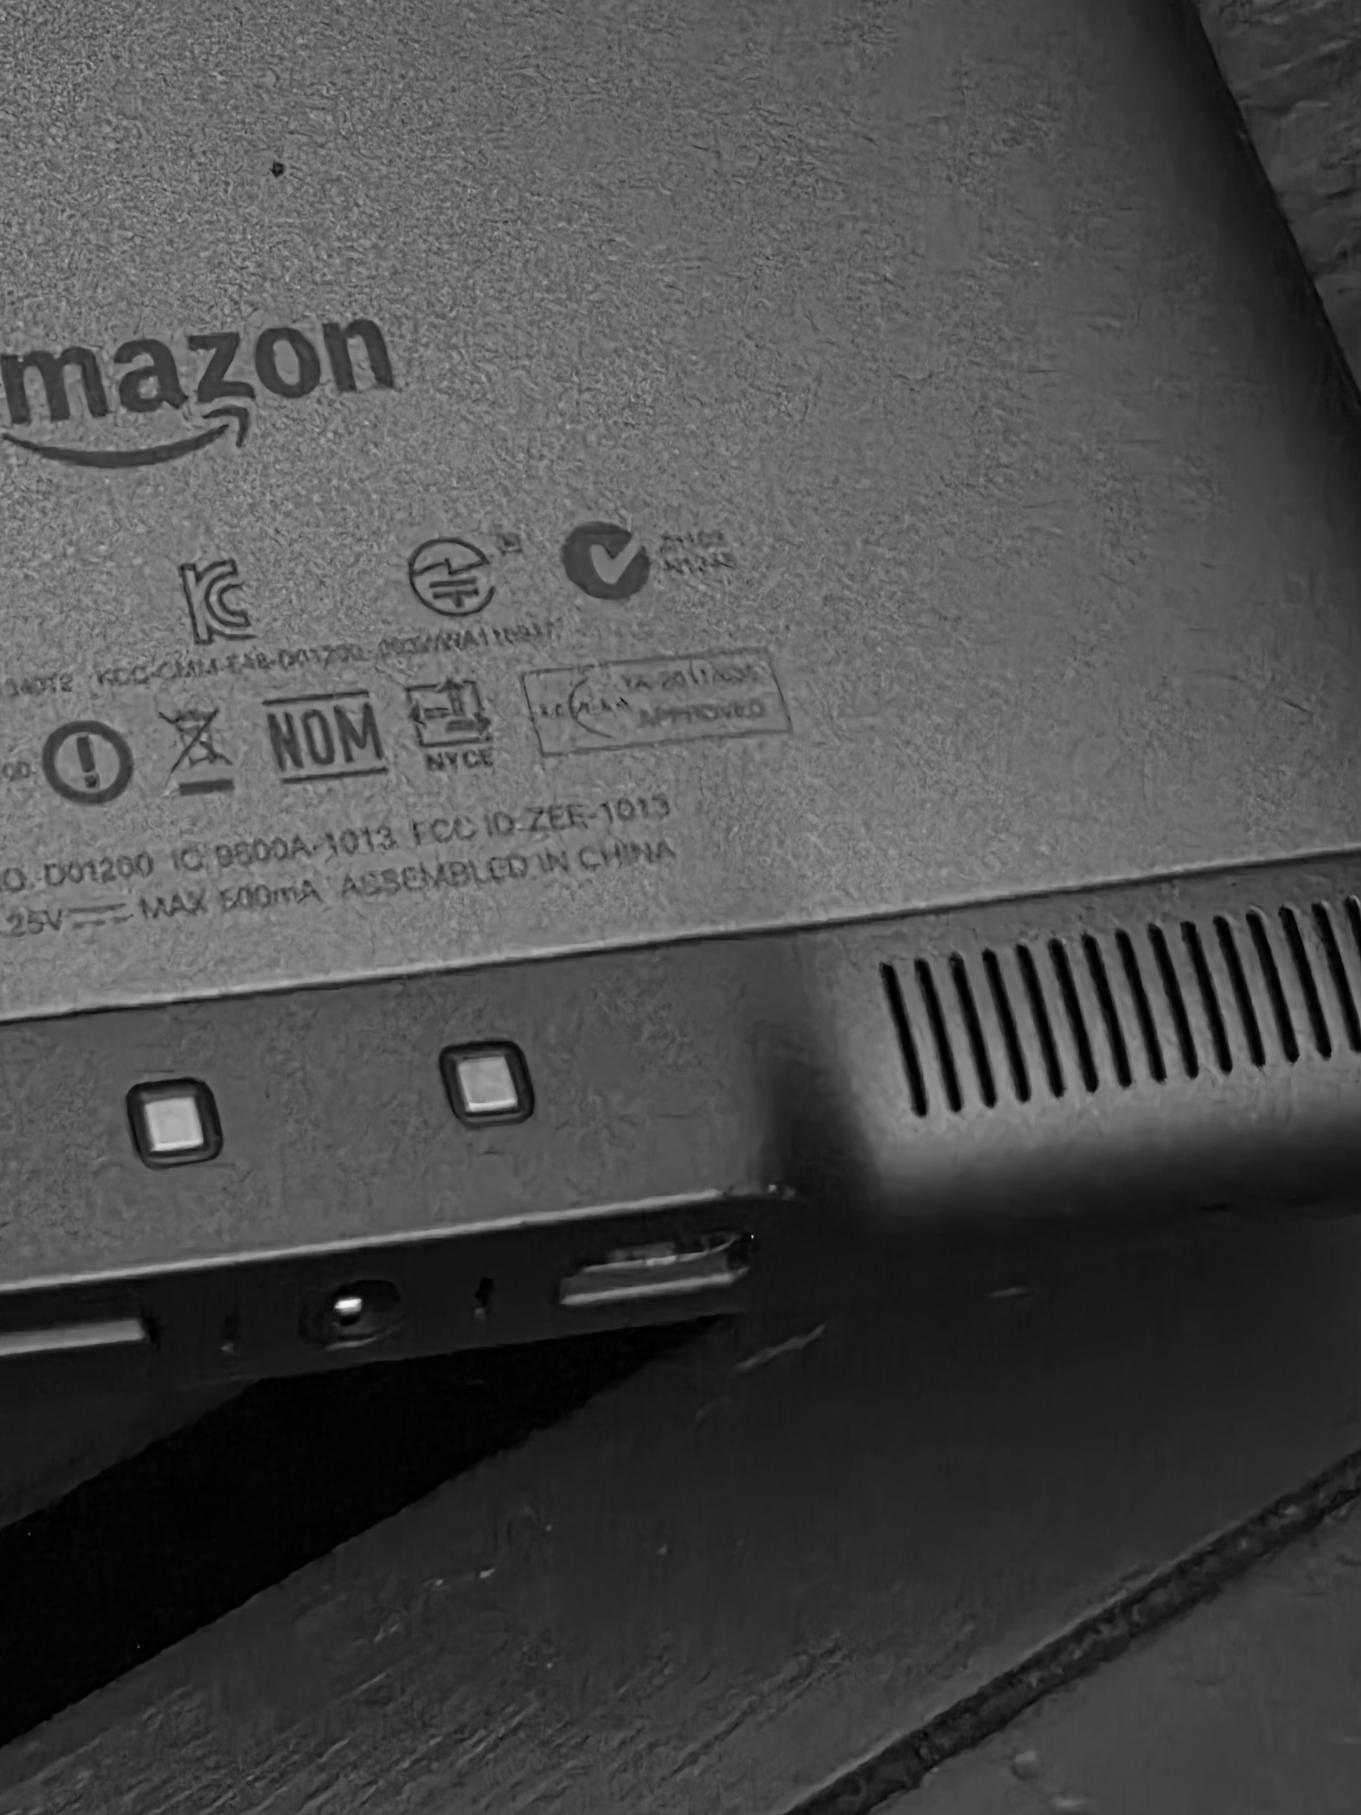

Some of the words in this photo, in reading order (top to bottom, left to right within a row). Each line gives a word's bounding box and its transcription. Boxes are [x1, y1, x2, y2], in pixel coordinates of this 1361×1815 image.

[266, 702, 386, 772] NOM
[411, 815, 476, 846] FCC
[341, 852, 529, 899] ASSEMBLED
[537, 846, 570, 875] IN
[577, 838, 677, 872] CHINA
